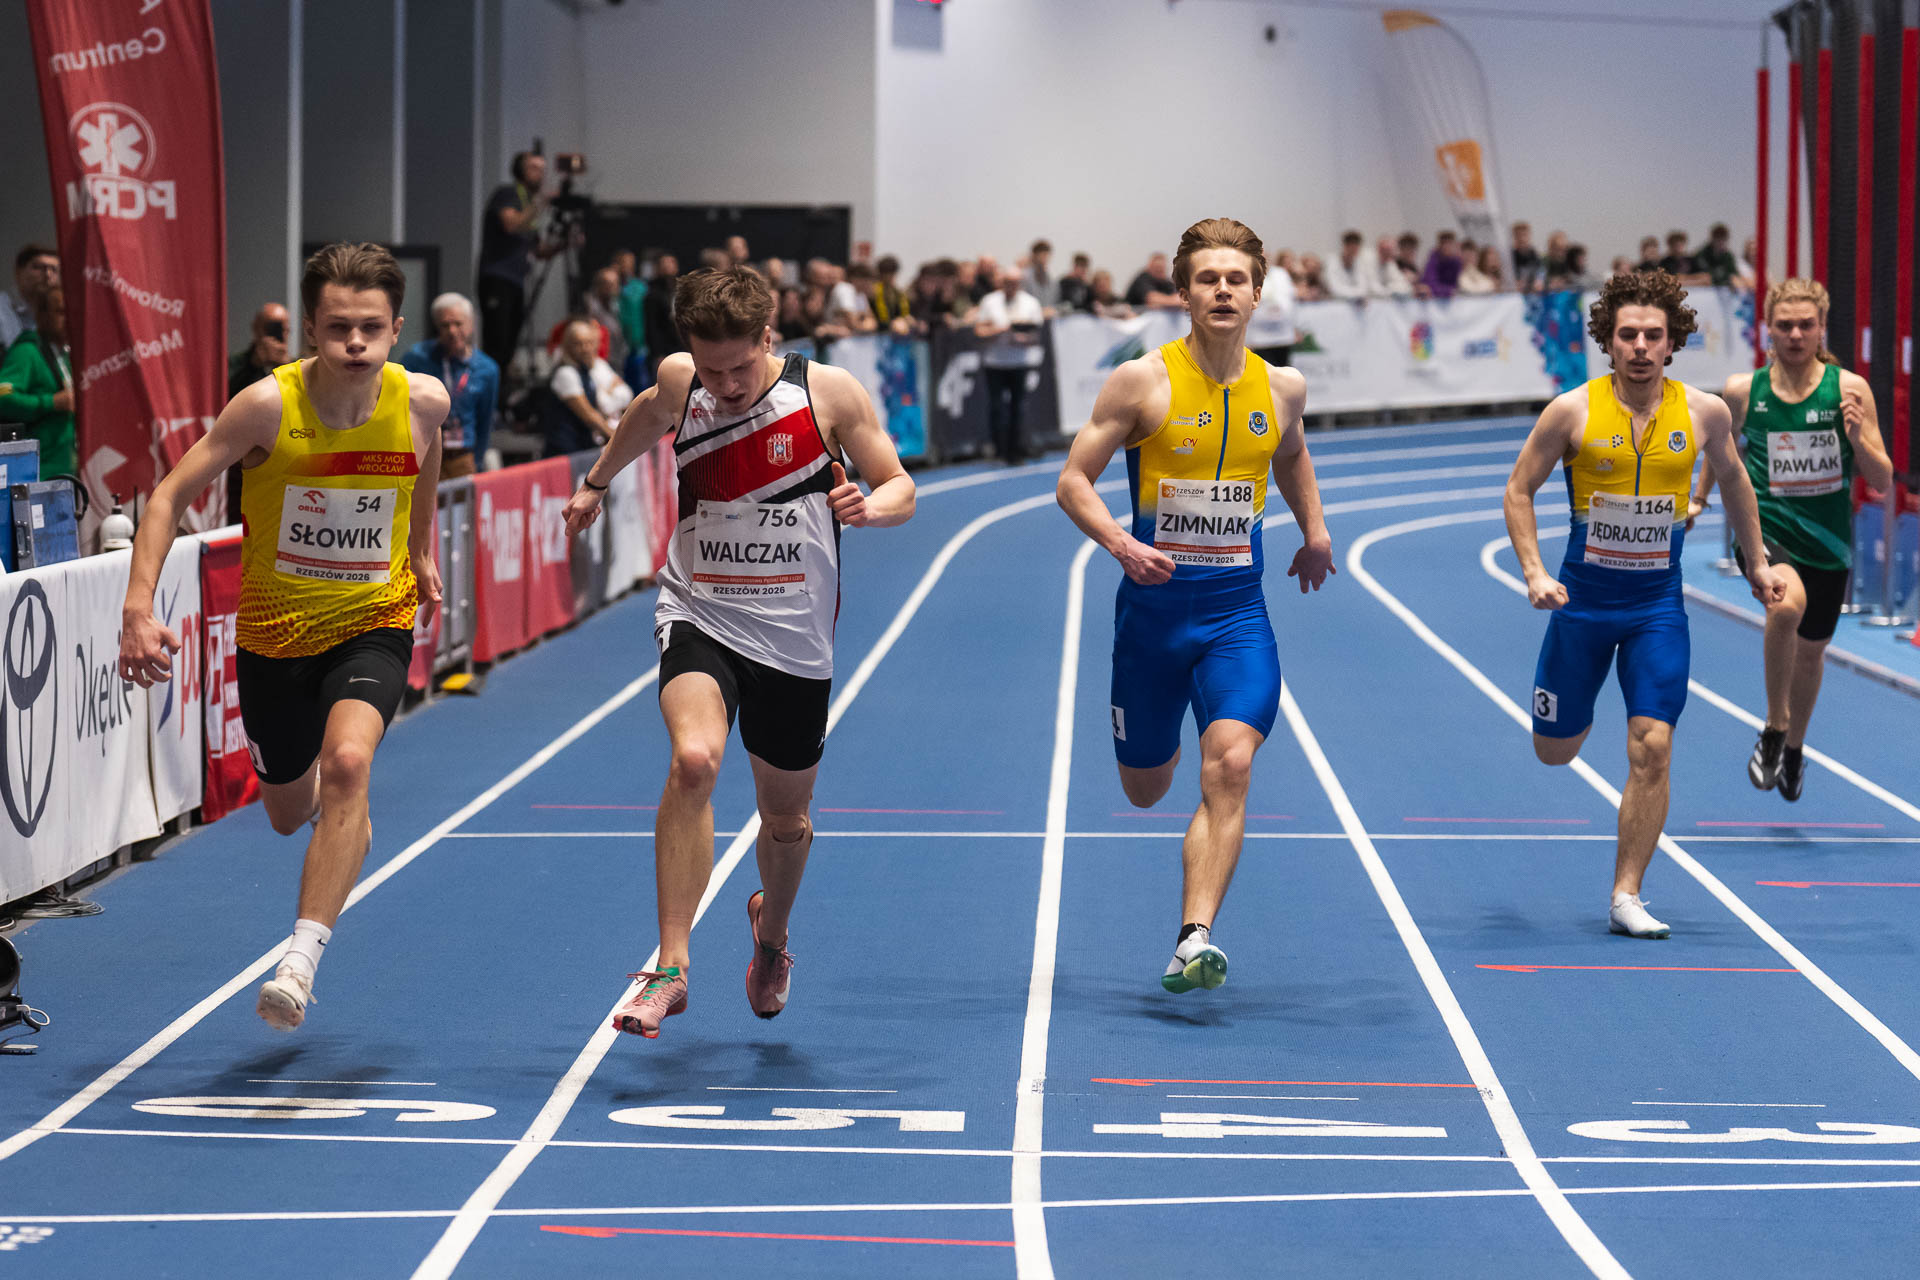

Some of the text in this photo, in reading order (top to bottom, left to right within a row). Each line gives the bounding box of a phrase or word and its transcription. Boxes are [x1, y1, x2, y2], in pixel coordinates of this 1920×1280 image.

[1810, 434, 1836, 448] 250
[362, 455, 405, 464] MKS MOS
[1773, 456, 1839, 473] PAWLAK
[357, 464, 405, 473] WROCŁAW
[1210, 485, 1252, 502] 1188
[297, 504, 326, 514] ORLEN
[355, 496, 381, 513] 54
[1635, 500, 1673, 515] 1164
[757, 508, 798, 527] 756
[1160, 513, 1250, 535] ZIMNIAK
[289, 522, 383, 549] SŁOWIK
[1591, 521, 1668, 543] JĘDRAJCZYK
[699, 540, 802, 564] WALCZAK
[1171, 553, 1235, 564] RZESZÓW 2026
[295, 567, 370, 581] RZESZÓW 2026
[713, 587, 785, 595] RZESZÓW 2026
[1536, 691, 1550, 717] 3
[608, 1105, 965, 1132] 5
[1092, 1111, 1448, 1139] 4
